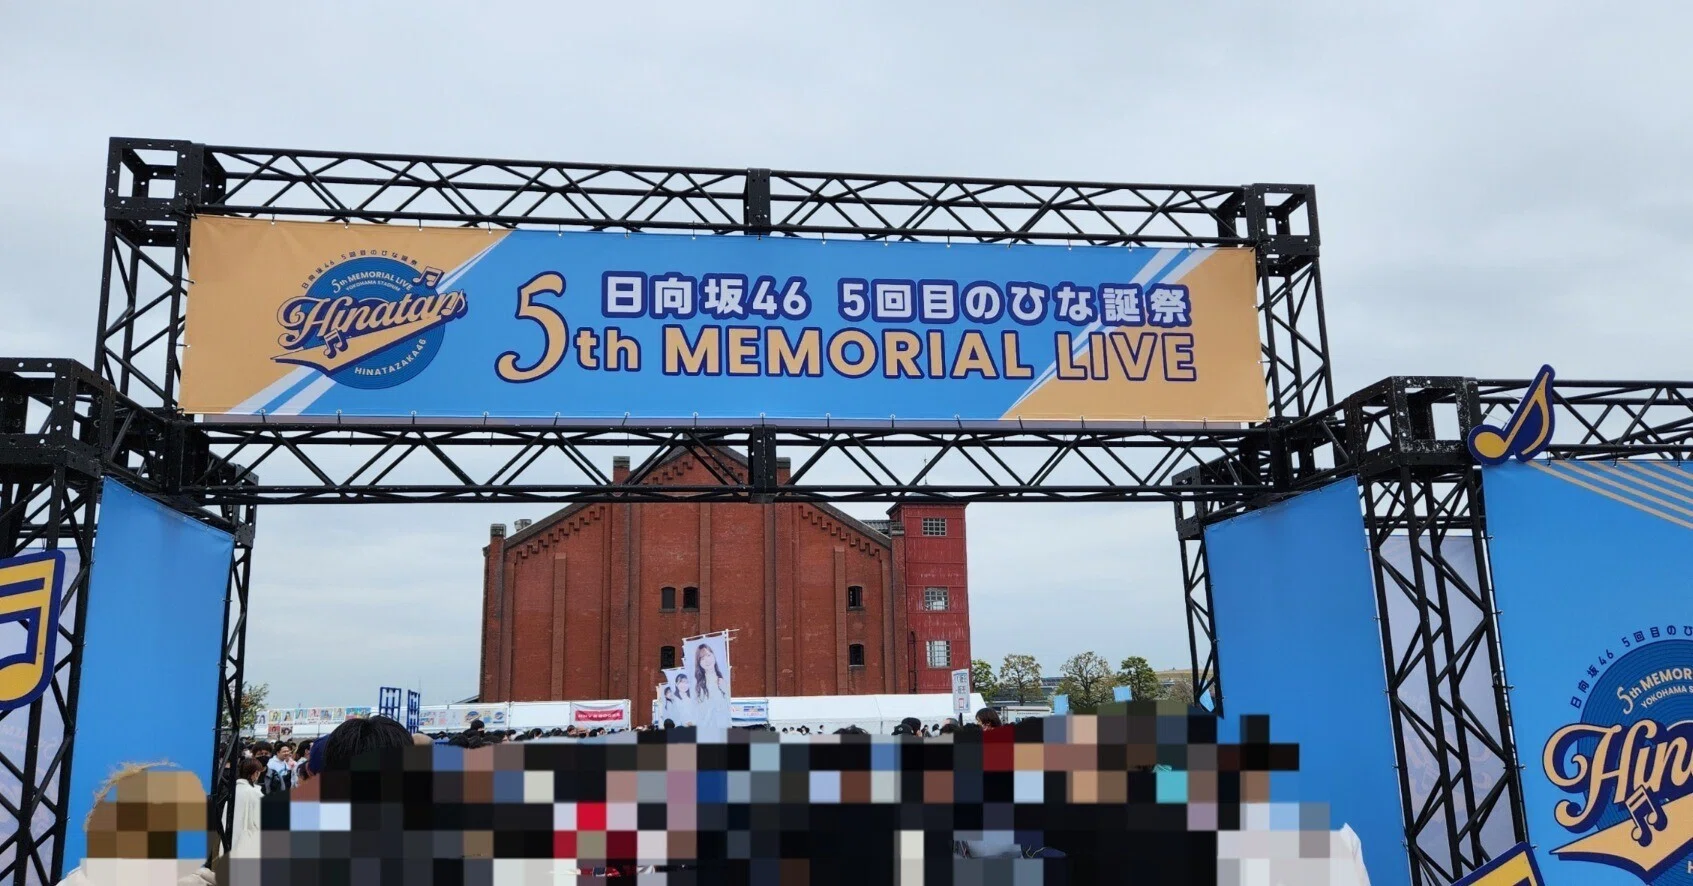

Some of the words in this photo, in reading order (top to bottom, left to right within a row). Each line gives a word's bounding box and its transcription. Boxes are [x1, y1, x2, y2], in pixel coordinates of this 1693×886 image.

[331, 278, 348, 294] 5th
[348, 270, 395, 282] MEMORIAL
[395, 276, 413, 291] LIVE
[345, 279, 377, 291] YOKOHAMA
[377, 280, 401, 292] STADIUM
[604, 272, 810, 319] 日向坂46
[840, 279, 1190, 326] 5回目のひな誕祭
[494, 271, 641, 383] 5th
[662, 324, 1034, 380] MEMORIAL
[1055, 332, 1197, 381] LIVE
[355, 338, 427, 376] HINATAZAKA46
[1570, 649, 1614, 709] 日向坂46
[1641, 685, 1686, 709] YOKOHAMA
[1616, 686, 1642, 715] 5th
[1542, 718, 1693, 833] Hin
